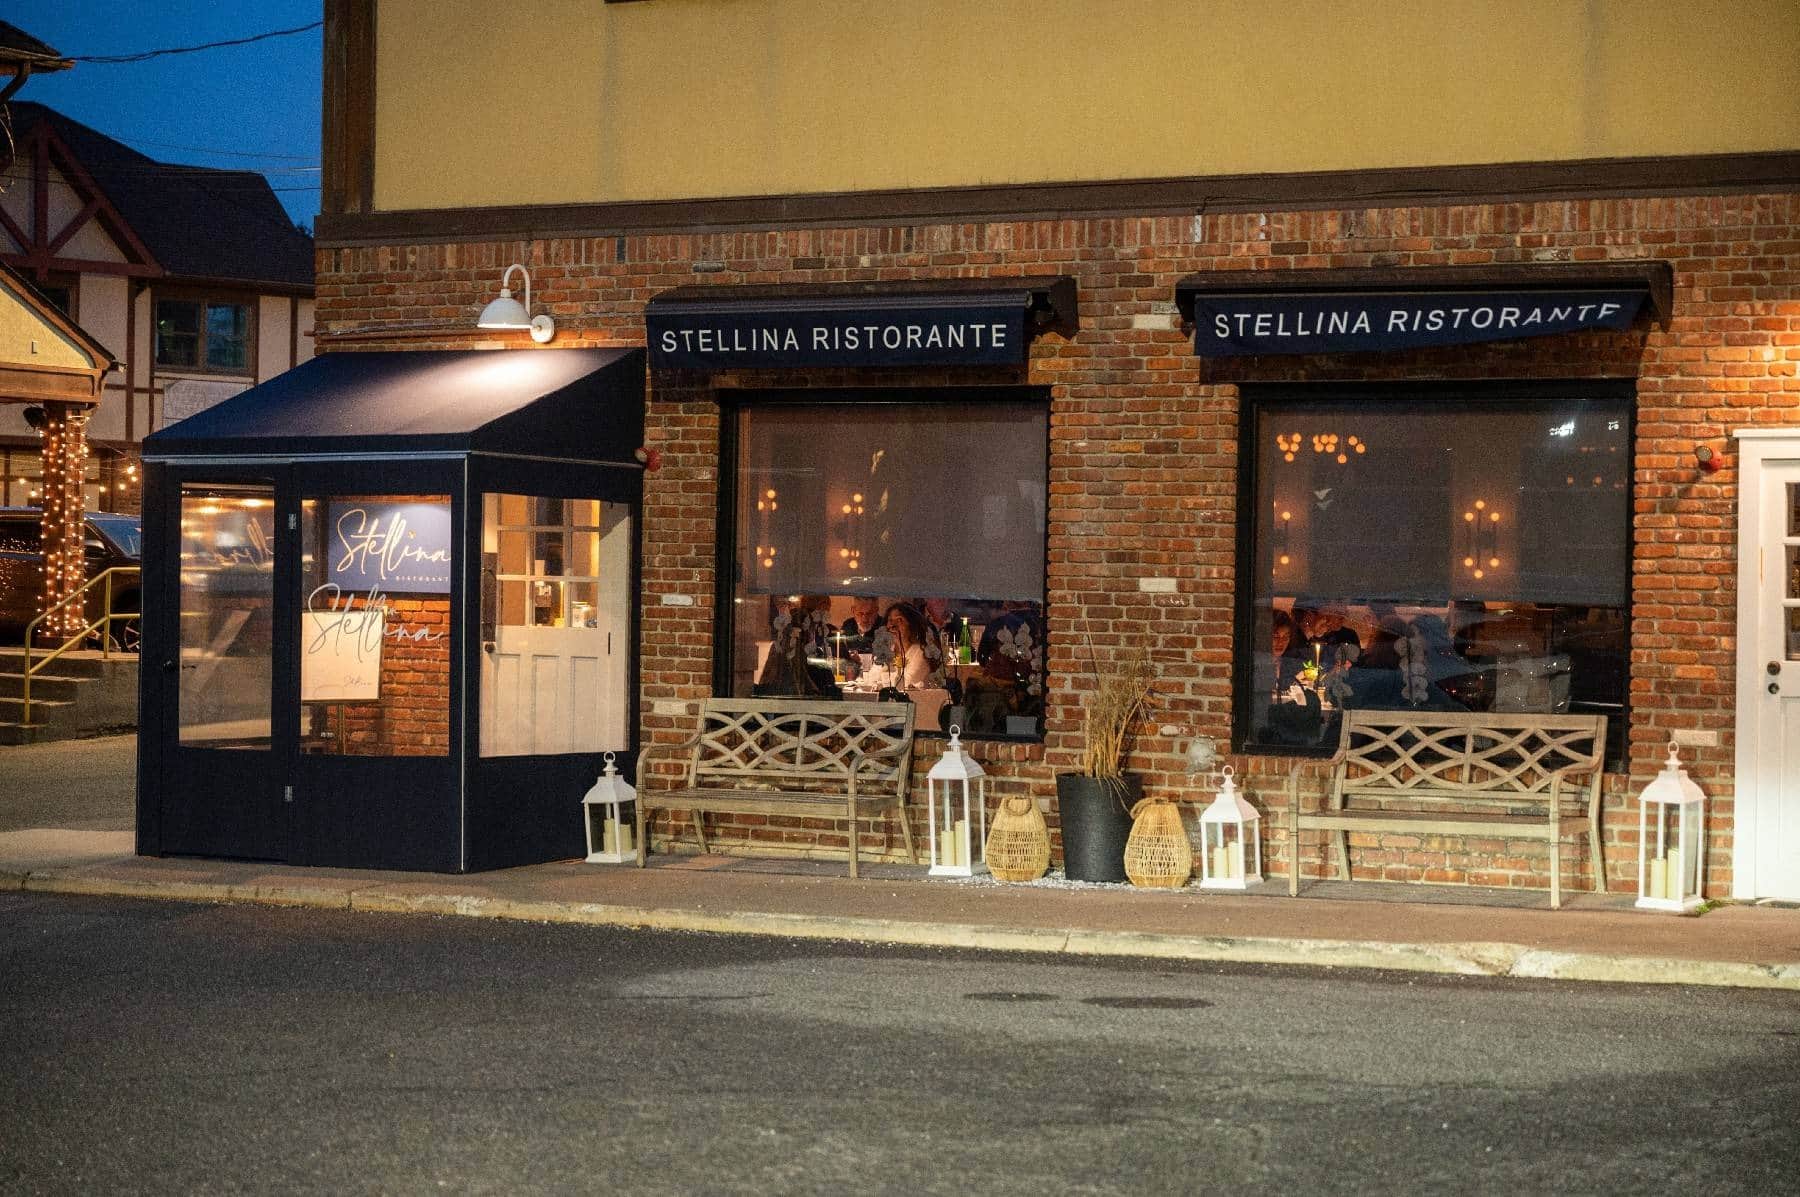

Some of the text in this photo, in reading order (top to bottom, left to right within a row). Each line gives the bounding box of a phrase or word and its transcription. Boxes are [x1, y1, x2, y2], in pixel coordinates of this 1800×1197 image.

[661, 324, 1007, 353] STELLINA RISTORANTE
[1215, 311, 1371, 337] STELLINA
[337, 508, 450, 580] Stellina
[308, 582, 441, 663] Stellina
